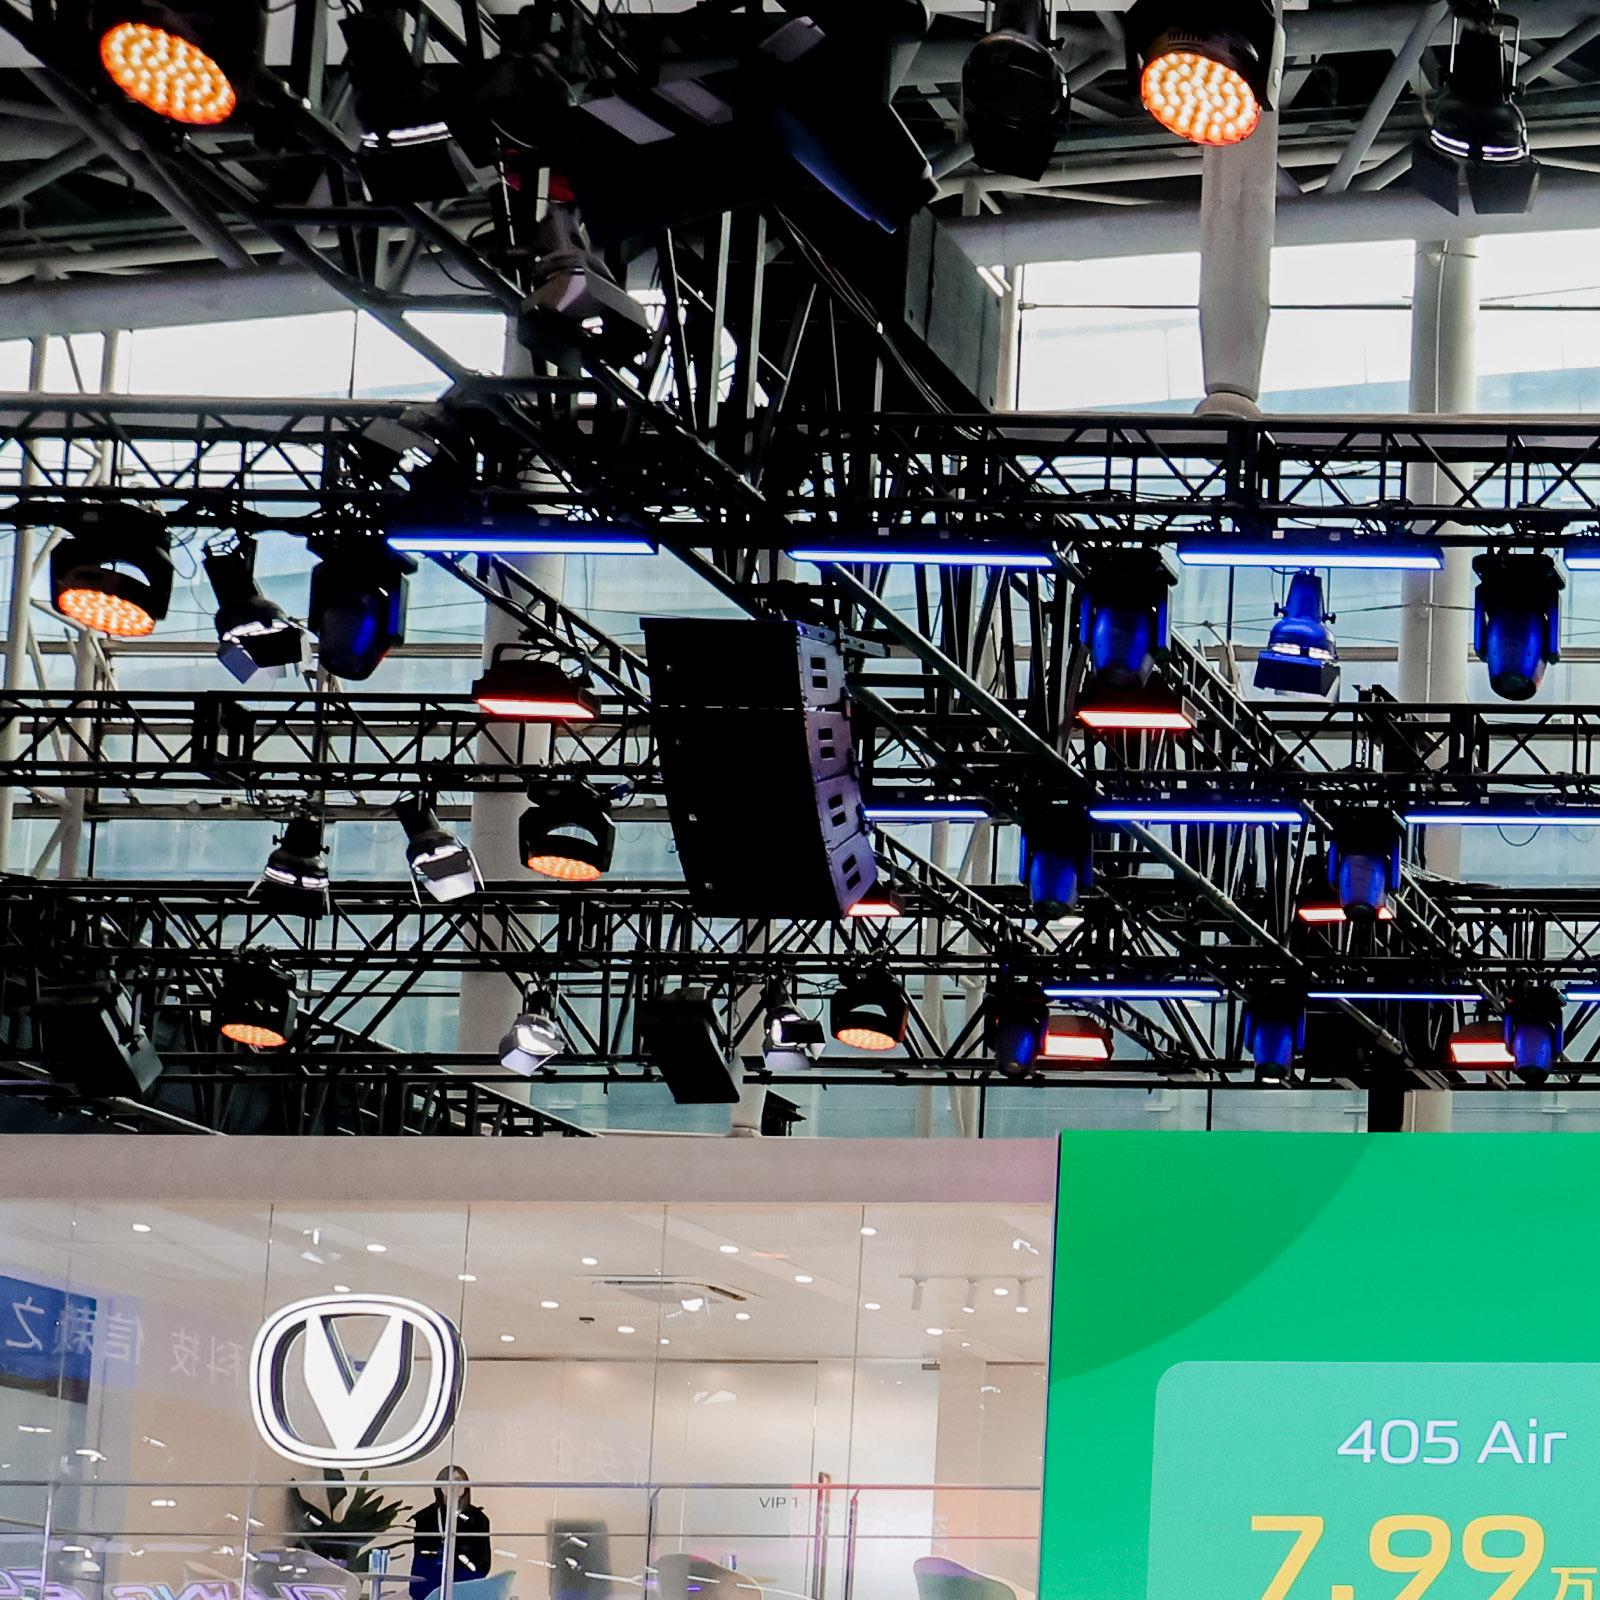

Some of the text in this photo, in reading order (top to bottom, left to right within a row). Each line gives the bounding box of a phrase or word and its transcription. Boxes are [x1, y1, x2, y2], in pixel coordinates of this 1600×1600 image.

[1338, 1418, 1567, 1465] 405 Air
[758, 1496, 798, 1509] VIP 1
